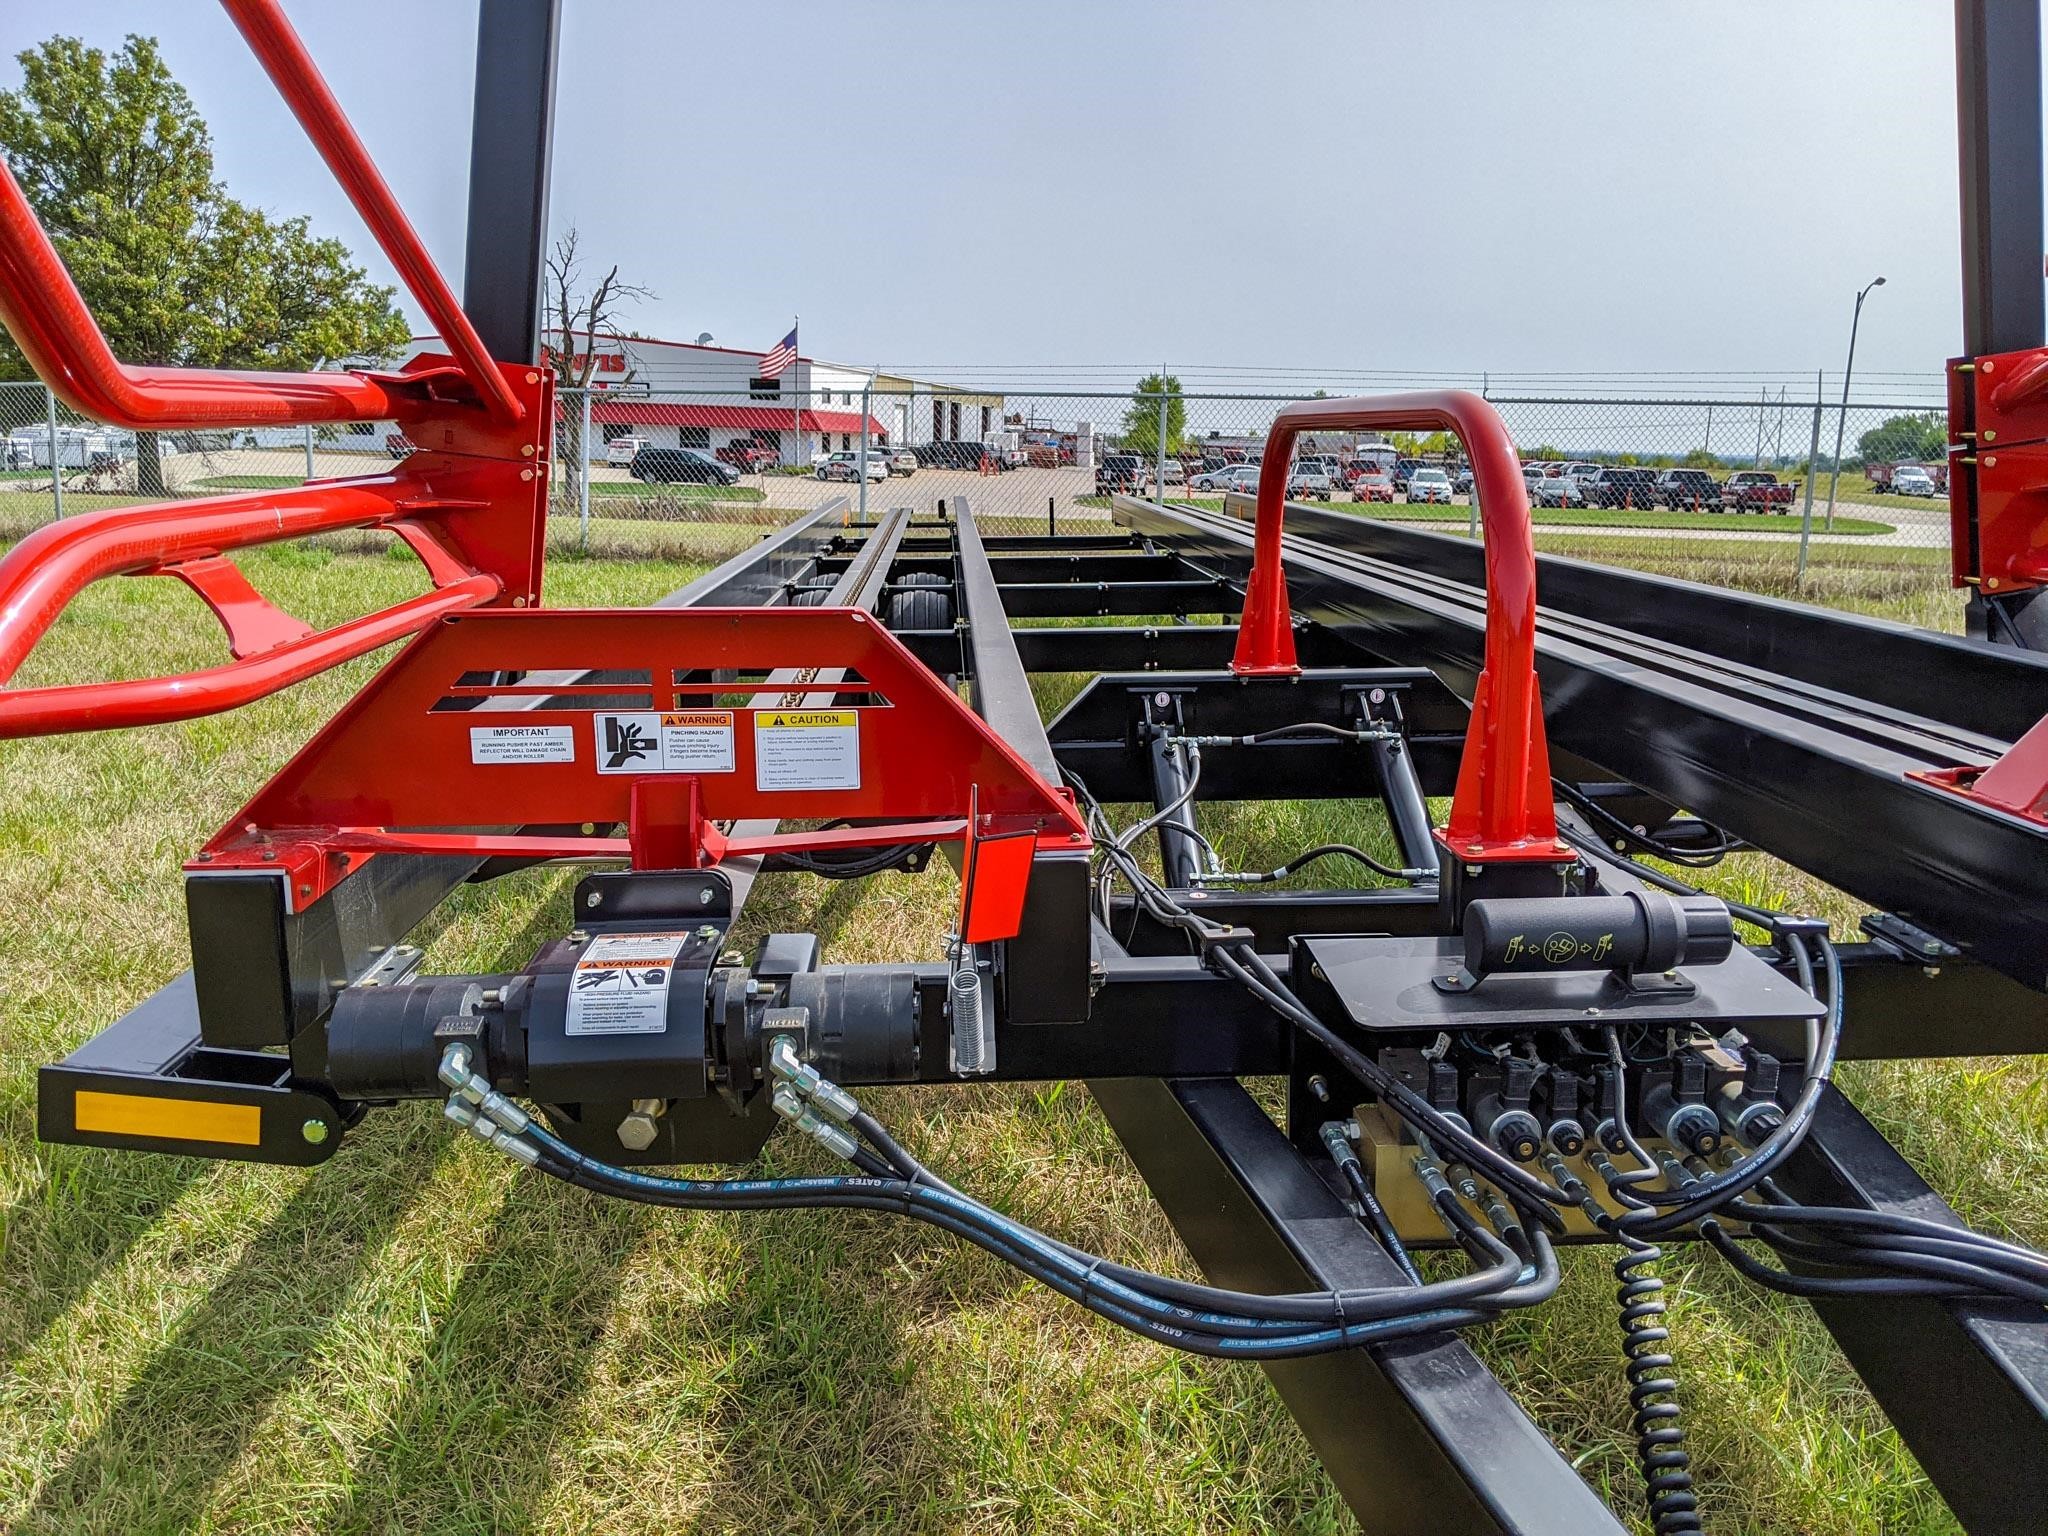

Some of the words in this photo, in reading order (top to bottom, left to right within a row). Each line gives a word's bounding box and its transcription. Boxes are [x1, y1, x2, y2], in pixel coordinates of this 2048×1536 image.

[677, 715, 727, 724] WARNING
[790, 715, 839, 724] CAUTION
[493, 728, 550, 737] IMPORTANT
[602, 959, 667, 967] WARNING
[847, 1177, 882, 1187] GATES
[1366, 1193, 1380, 1213] GATES
[1151, 1322, 1183, 1337] GATES
